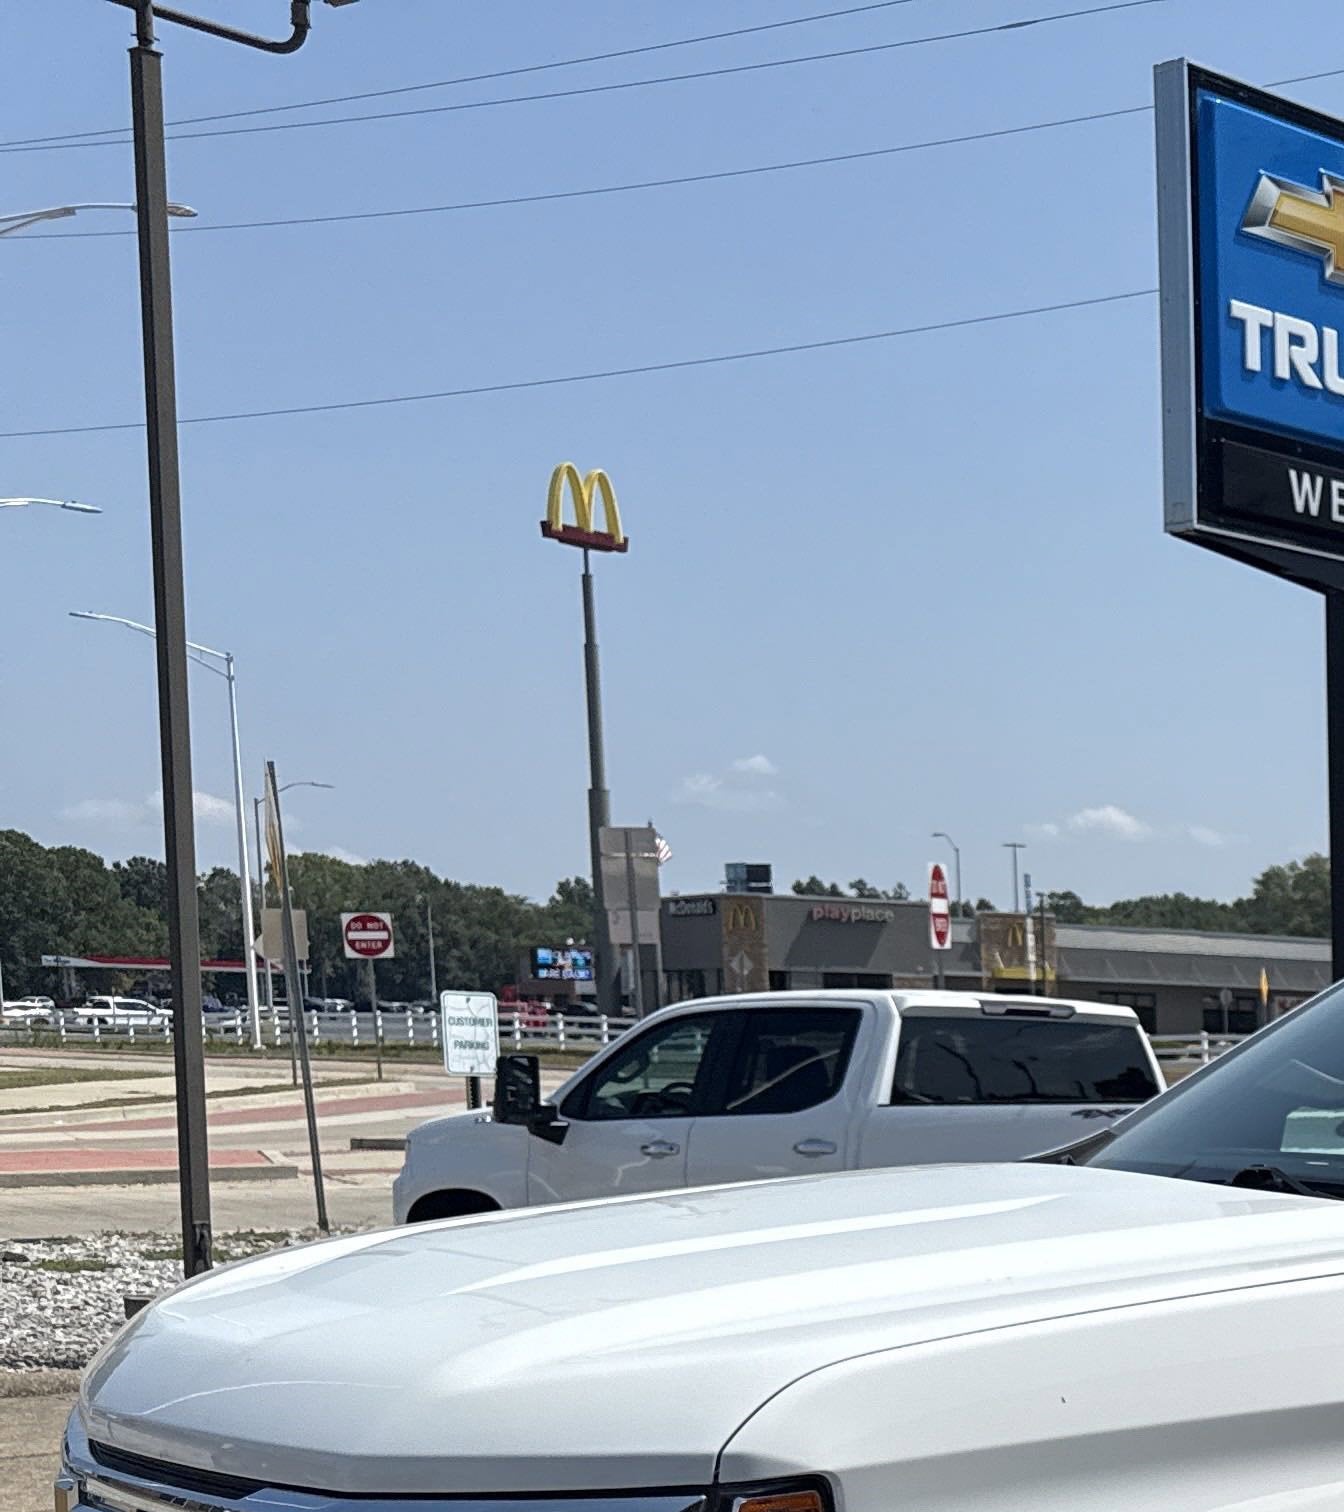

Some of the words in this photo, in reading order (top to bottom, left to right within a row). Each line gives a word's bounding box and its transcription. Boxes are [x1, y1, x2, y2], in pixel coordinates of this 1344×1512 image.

[812, 904, 895, 923] playplace
[350, 921, 363, 930] DO
[355, 940, 383, 950] ENTER
[447, 1016, 493, 1028] CUSTOMER
[453, 1040, 490, 1051] PARKING
